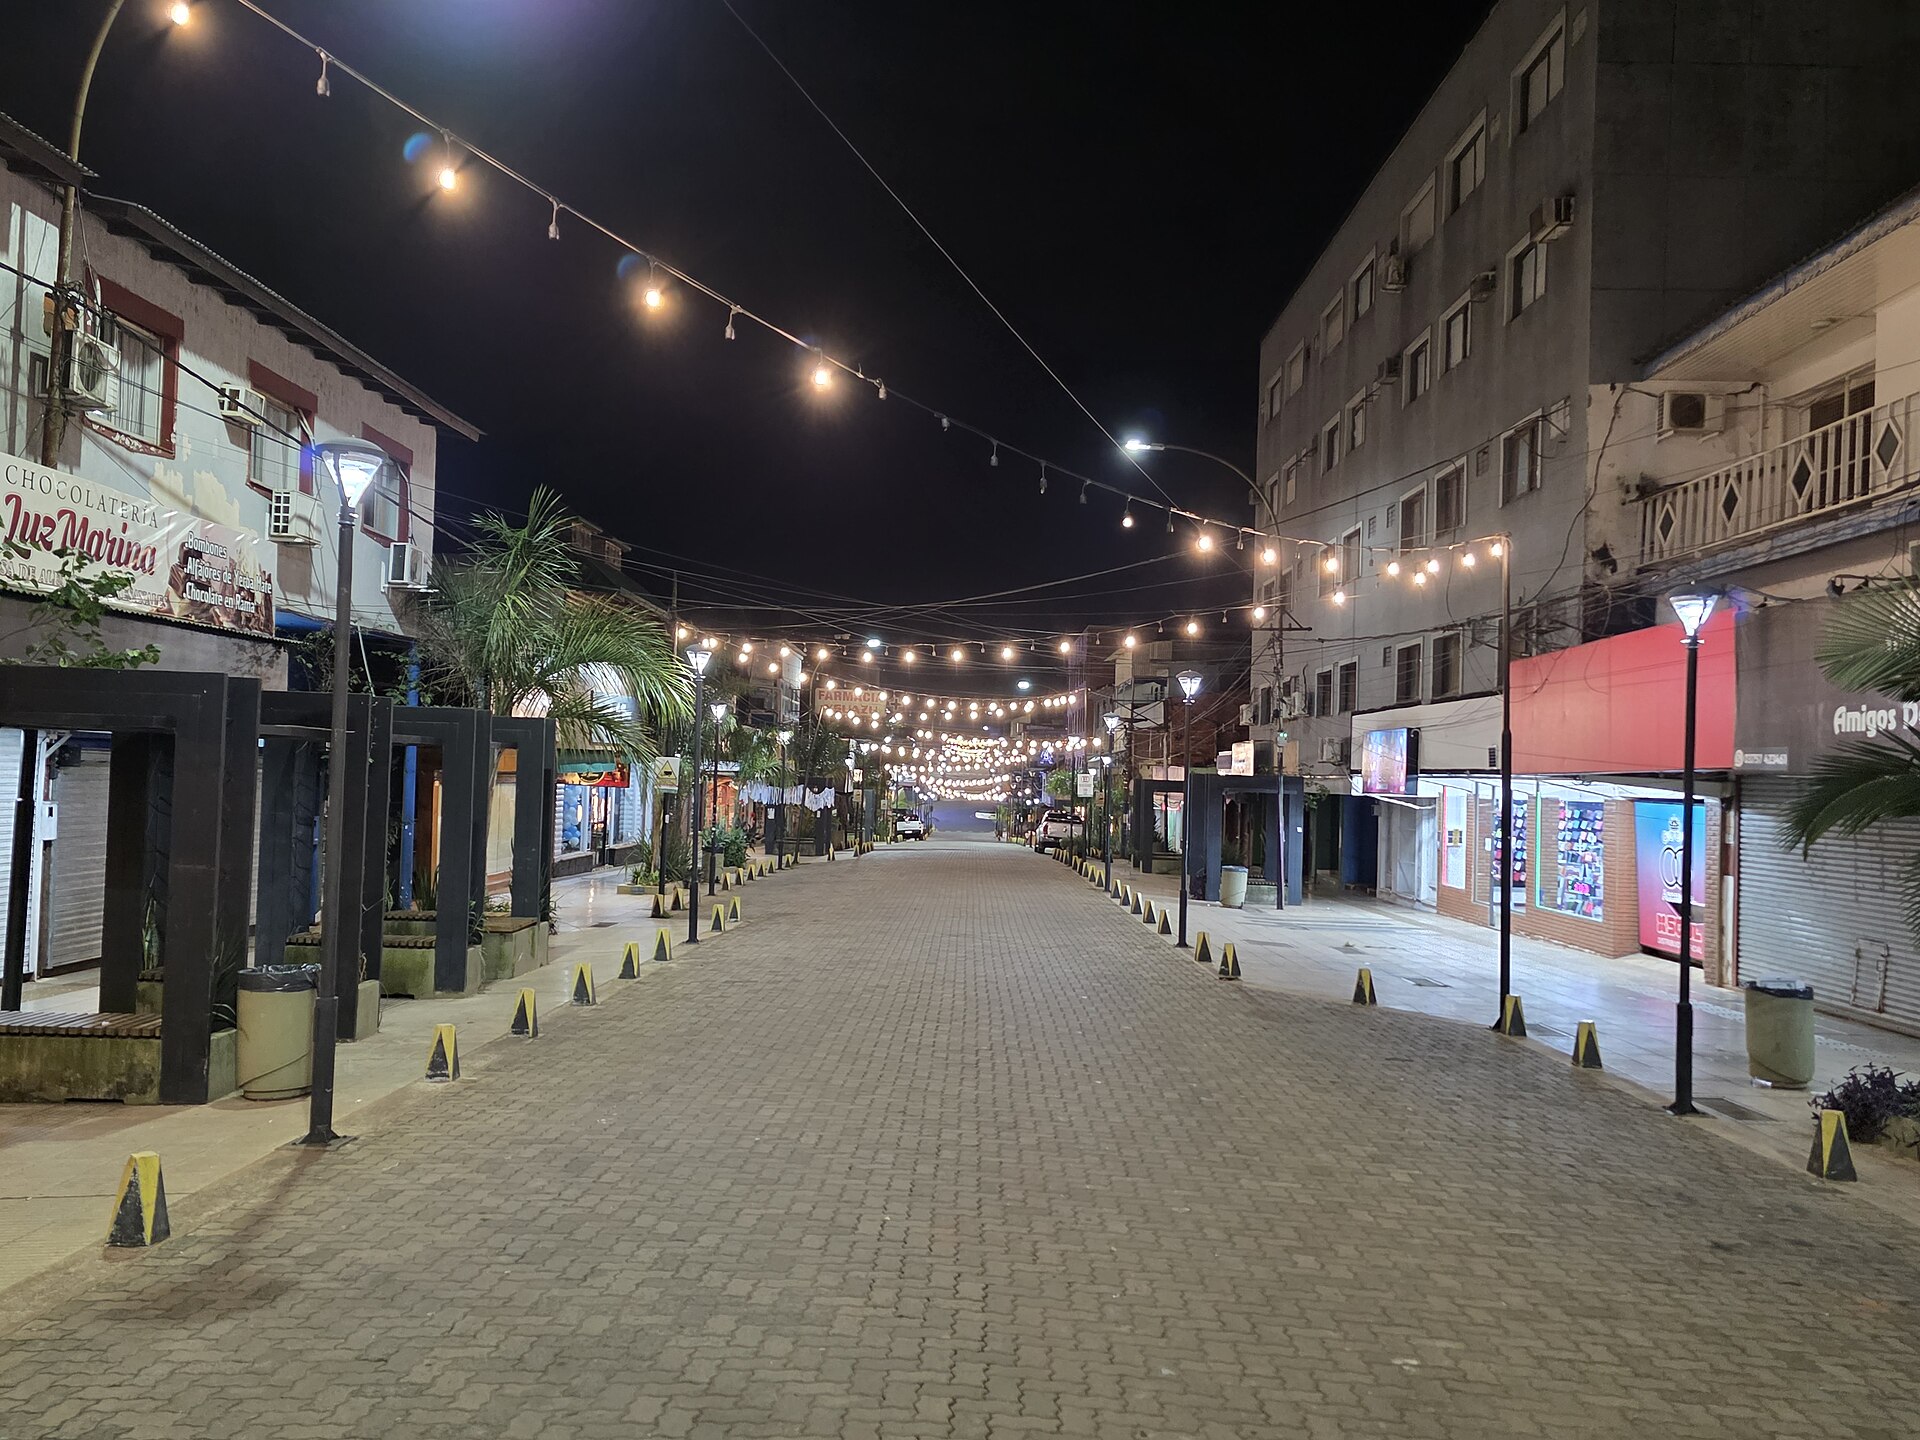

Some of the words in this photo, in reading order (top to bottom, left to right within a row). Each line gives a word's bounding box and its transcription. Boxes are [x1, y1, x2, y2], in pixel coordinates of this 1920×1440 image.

[5, 464, 159, 529] CHOCOLATERÍA
[3, 492, 57, 560] Luz
[56, 508, 157, 576] Marina
[222, 566, 233, 584] de
[224, 595, 234, 609] en
[235, 593, 256, 613] Rama
[1833, 704, 1897, 738] Amigos
